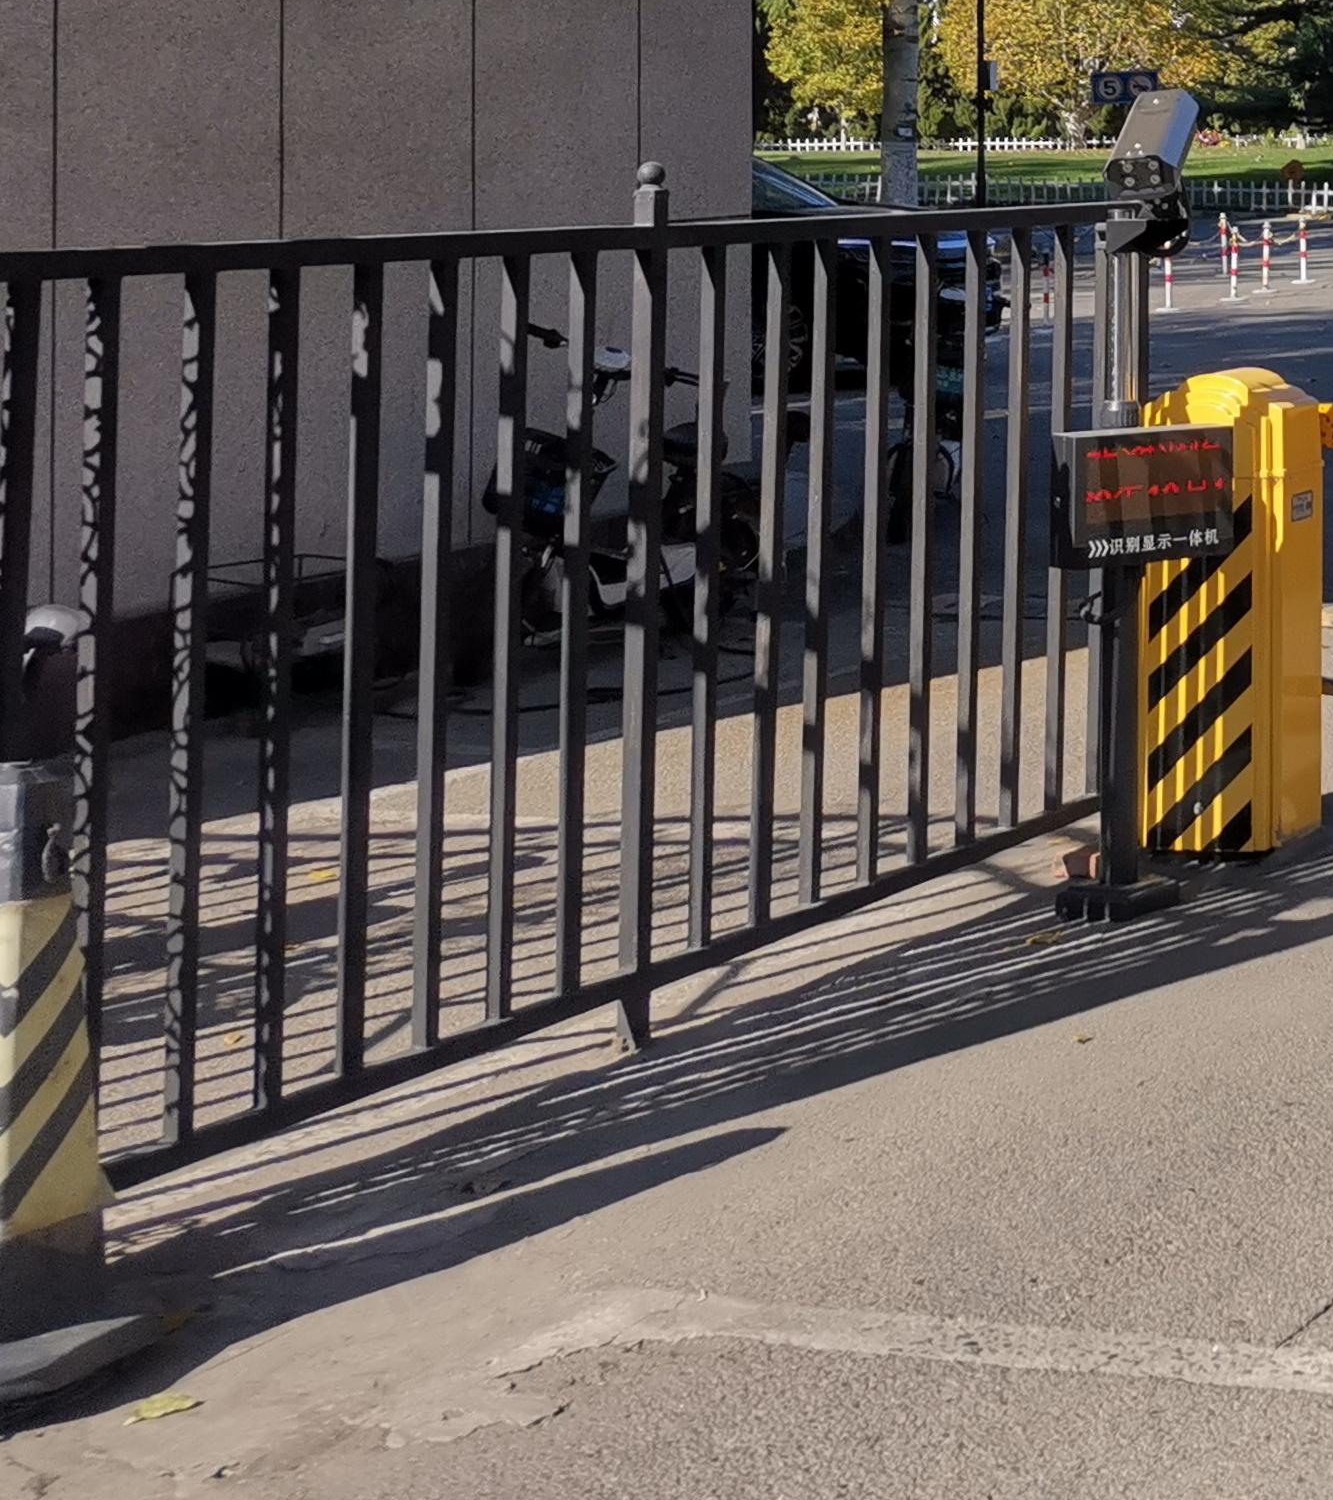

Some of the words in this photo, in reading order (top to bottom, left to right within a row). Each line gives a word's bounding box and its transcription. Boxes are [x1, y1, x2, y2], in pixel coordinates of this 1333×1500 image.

[1109, 528, 1220, 556] 识别显示一体机
